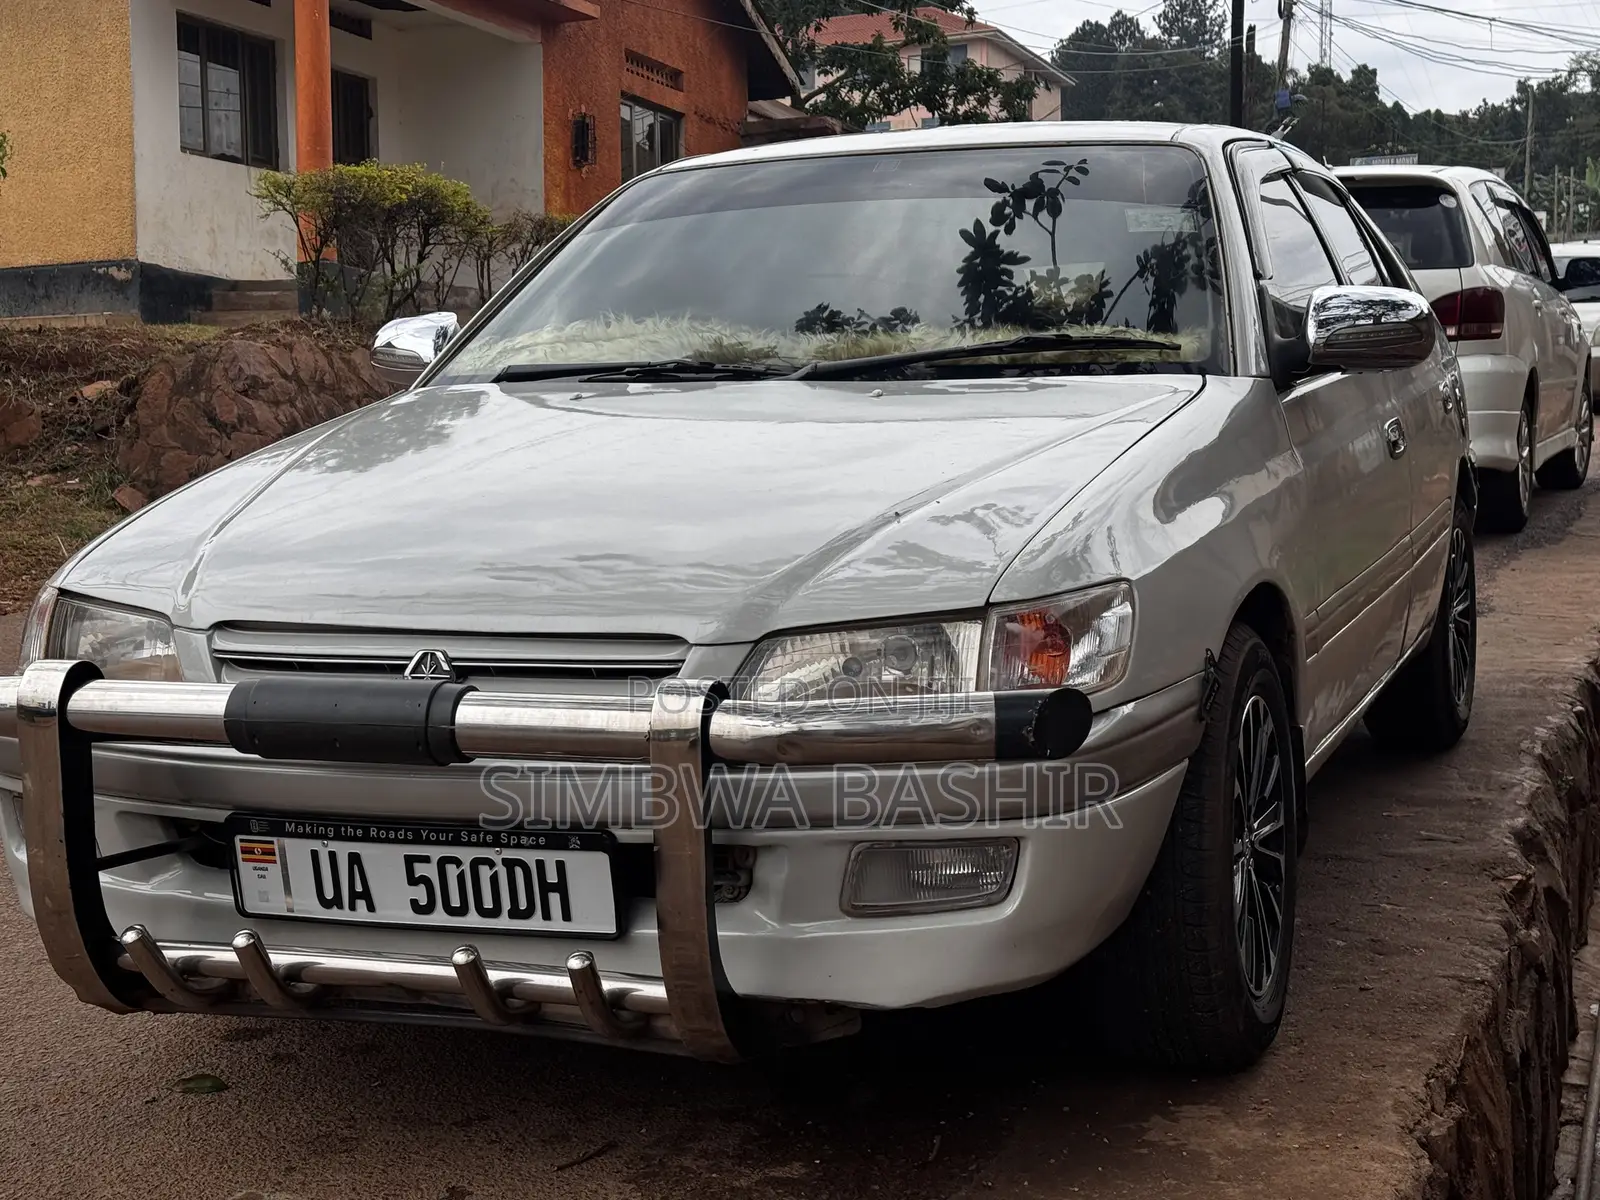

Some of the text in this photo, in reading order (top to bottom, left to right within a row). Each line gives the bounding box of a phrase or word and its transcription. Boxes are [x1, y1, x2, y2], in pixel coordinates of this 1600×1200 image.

[285, 822, 546, 846] Making the Roads Your Safe Space
[310, 848, 572, 923] UA 500DH
